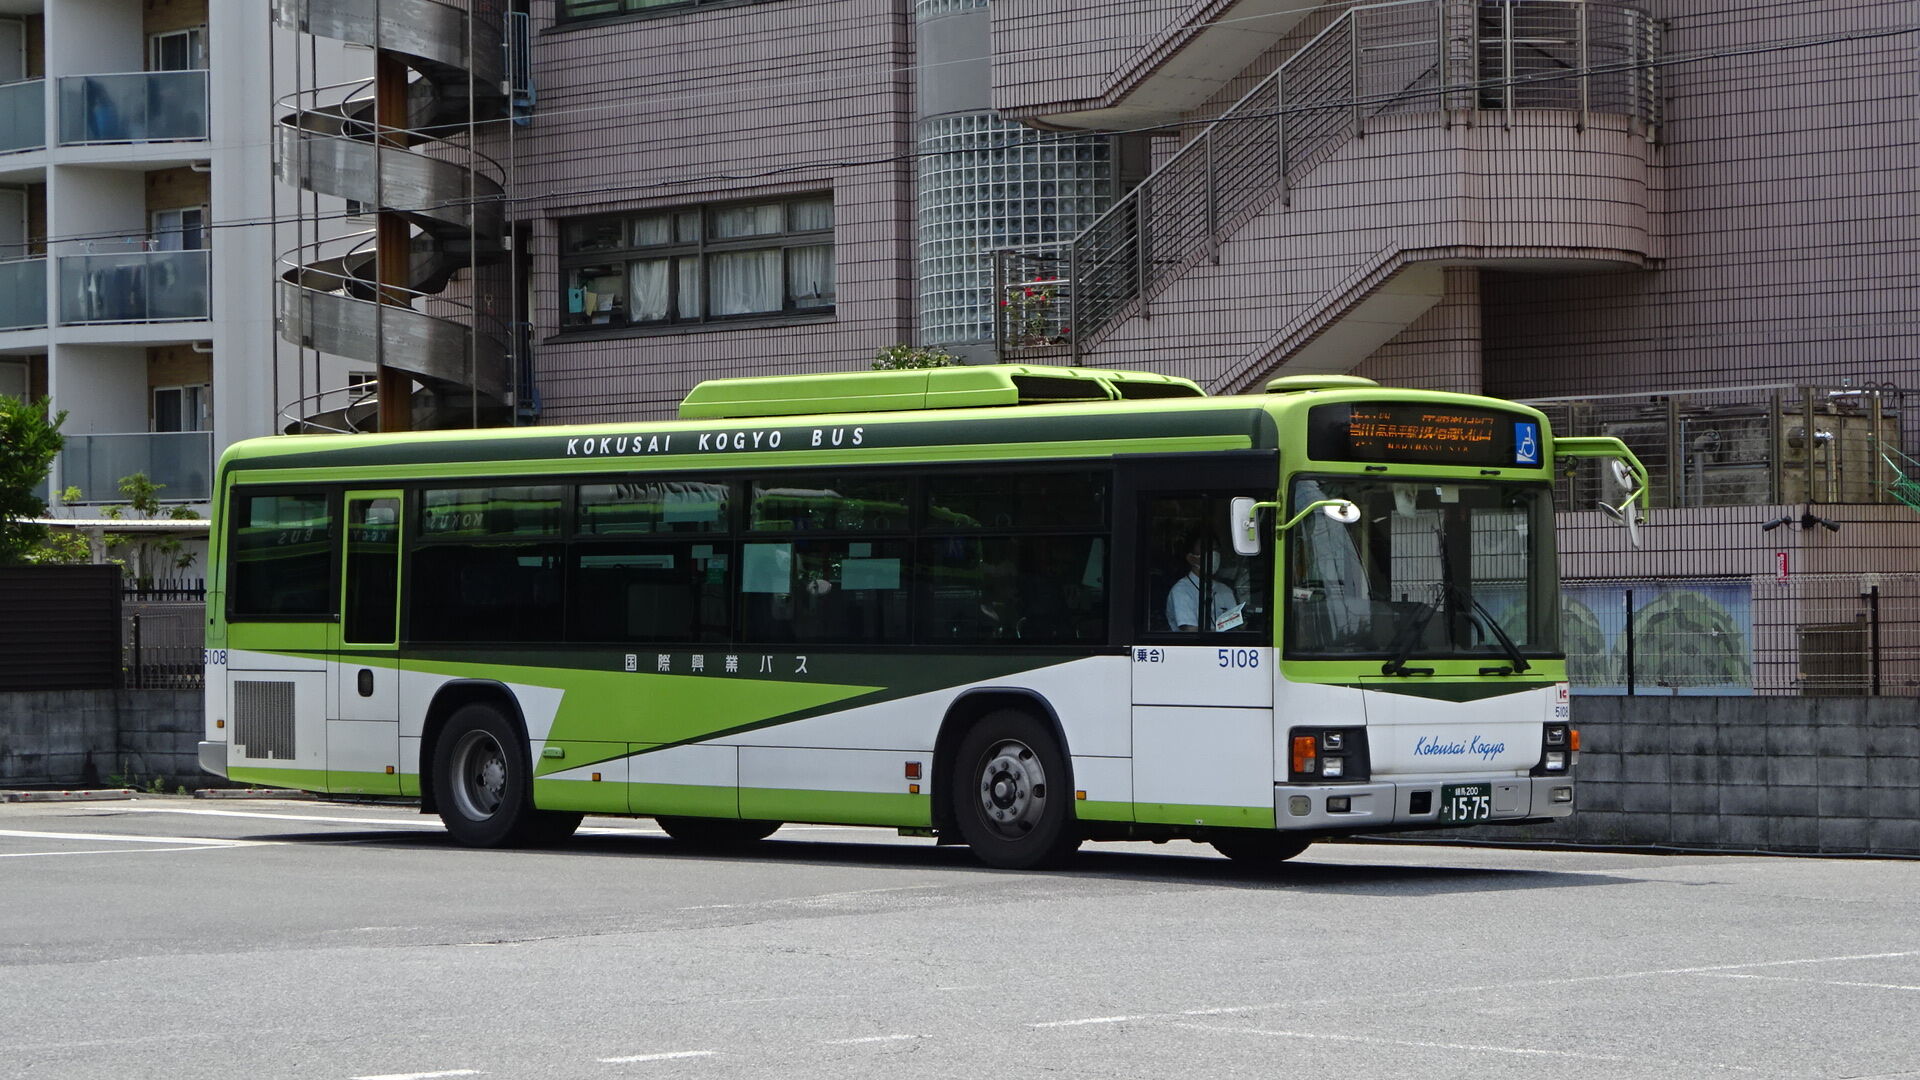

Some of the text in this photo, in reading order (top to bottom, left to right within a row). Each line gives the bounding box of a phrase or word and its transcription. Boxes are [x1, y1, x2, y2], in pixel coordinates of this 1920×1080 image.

[566, 427, 865, 456] KOKUSAI KOGYO BUS
[201, 649, 226, 665] 5108
[625, 653, 808, 674] 国際興業バス
[1132, 648, 1165, 663] (乗合)
[1218, 649, 1259, 668] 5108
[1555, 706, 1568, 718] 5108
[1414, 735, 1505, 761] Kokusai Kogyo
[1452, 796, 1490, 821] 15-75
